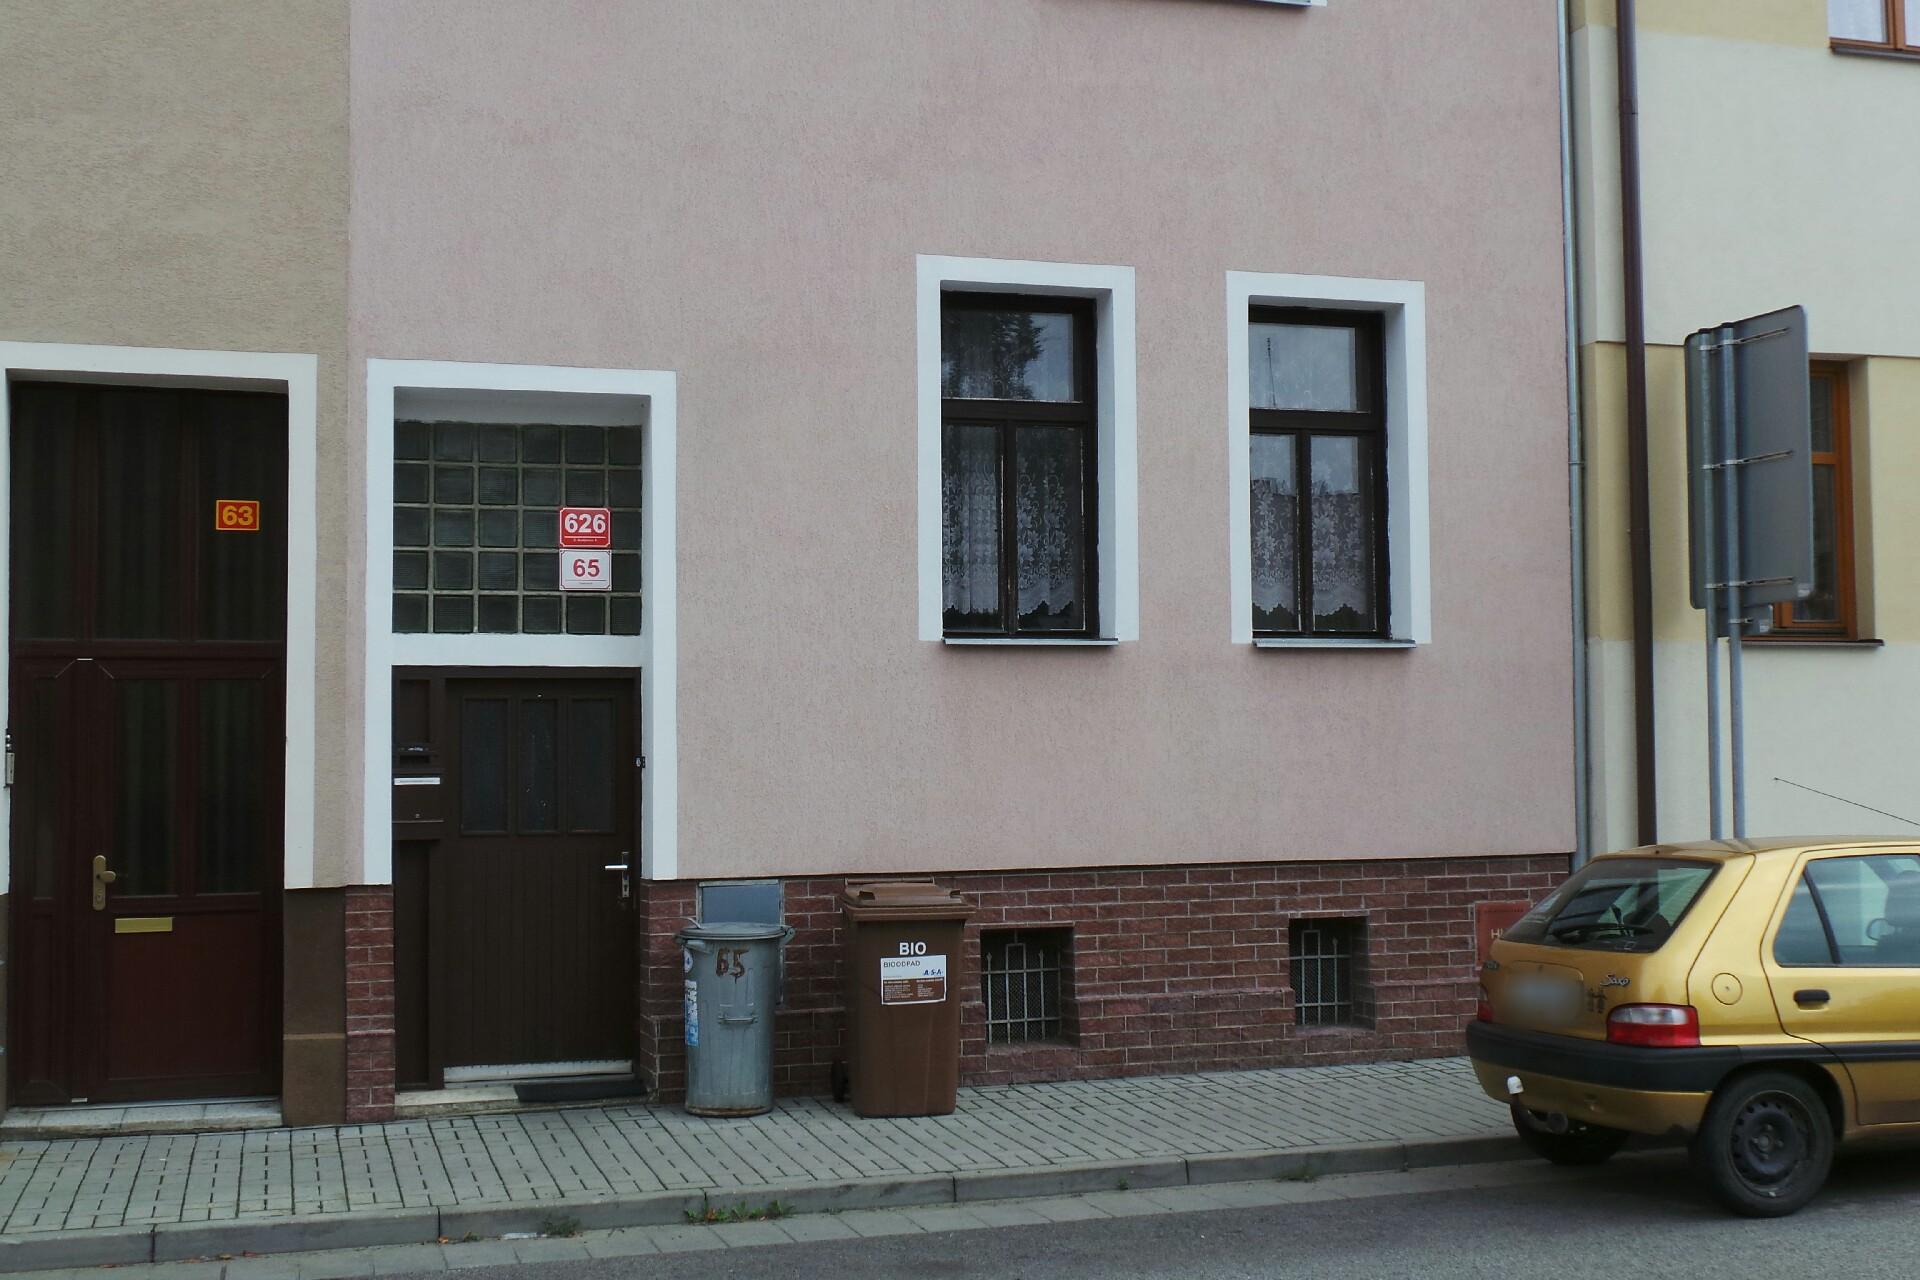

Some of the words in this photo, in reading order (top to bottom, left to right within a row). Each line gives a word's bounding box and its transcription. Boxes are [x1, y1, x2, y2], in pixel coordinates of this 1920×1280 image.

[222, 505, 254, 526] 63
[564, 513, 606, 534] 626
[573, 559, 600, 577] 65
[899, 941, 927, 956] BIO
[716, 946, 750, 978] 65
